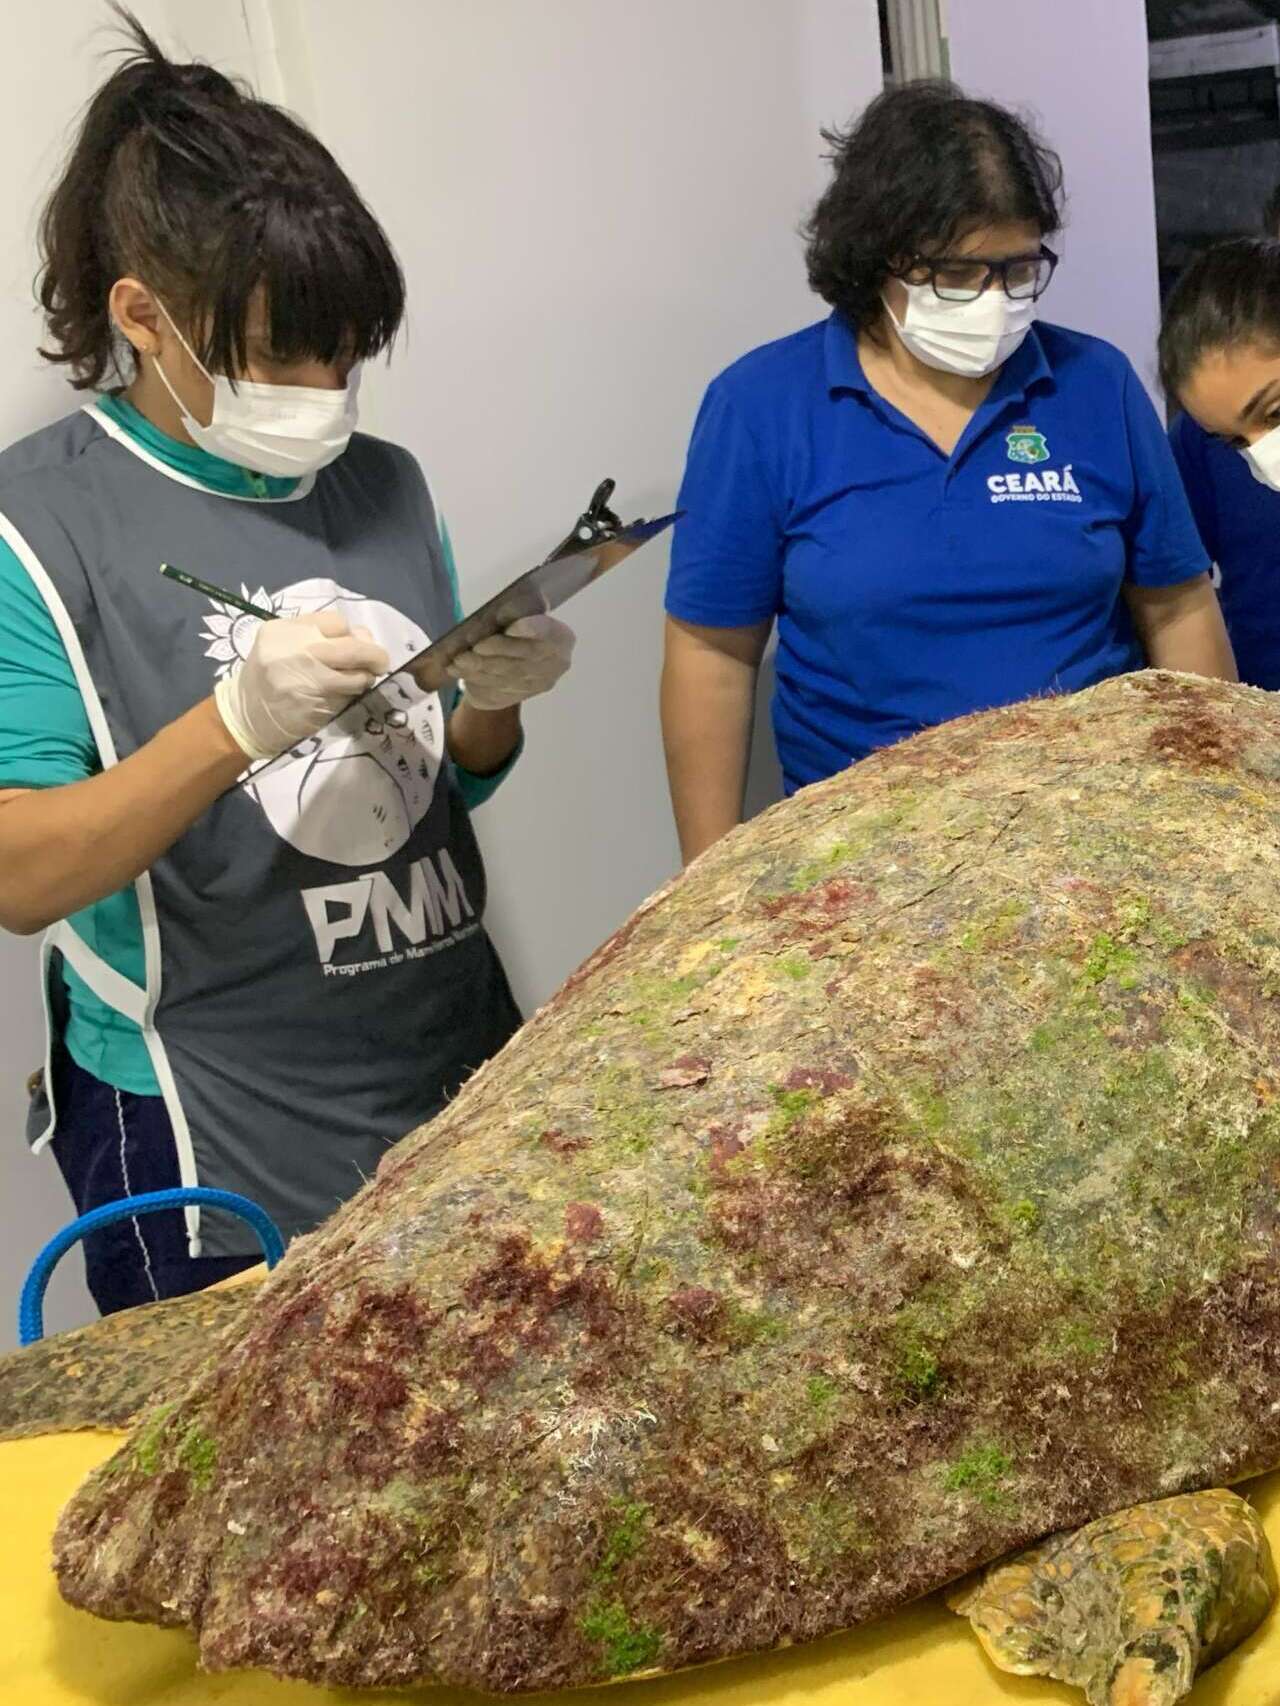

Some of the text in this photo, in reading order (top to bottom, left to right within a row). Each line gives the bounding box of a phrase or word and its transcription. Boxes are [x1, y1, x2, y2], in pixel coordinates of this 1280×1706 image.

[987, 464, 1080, 494] CEARÁ
[990, 492, 1082, 503] GOVERNO DO ESTADO
[323, 951, 404, 976] Programa de
